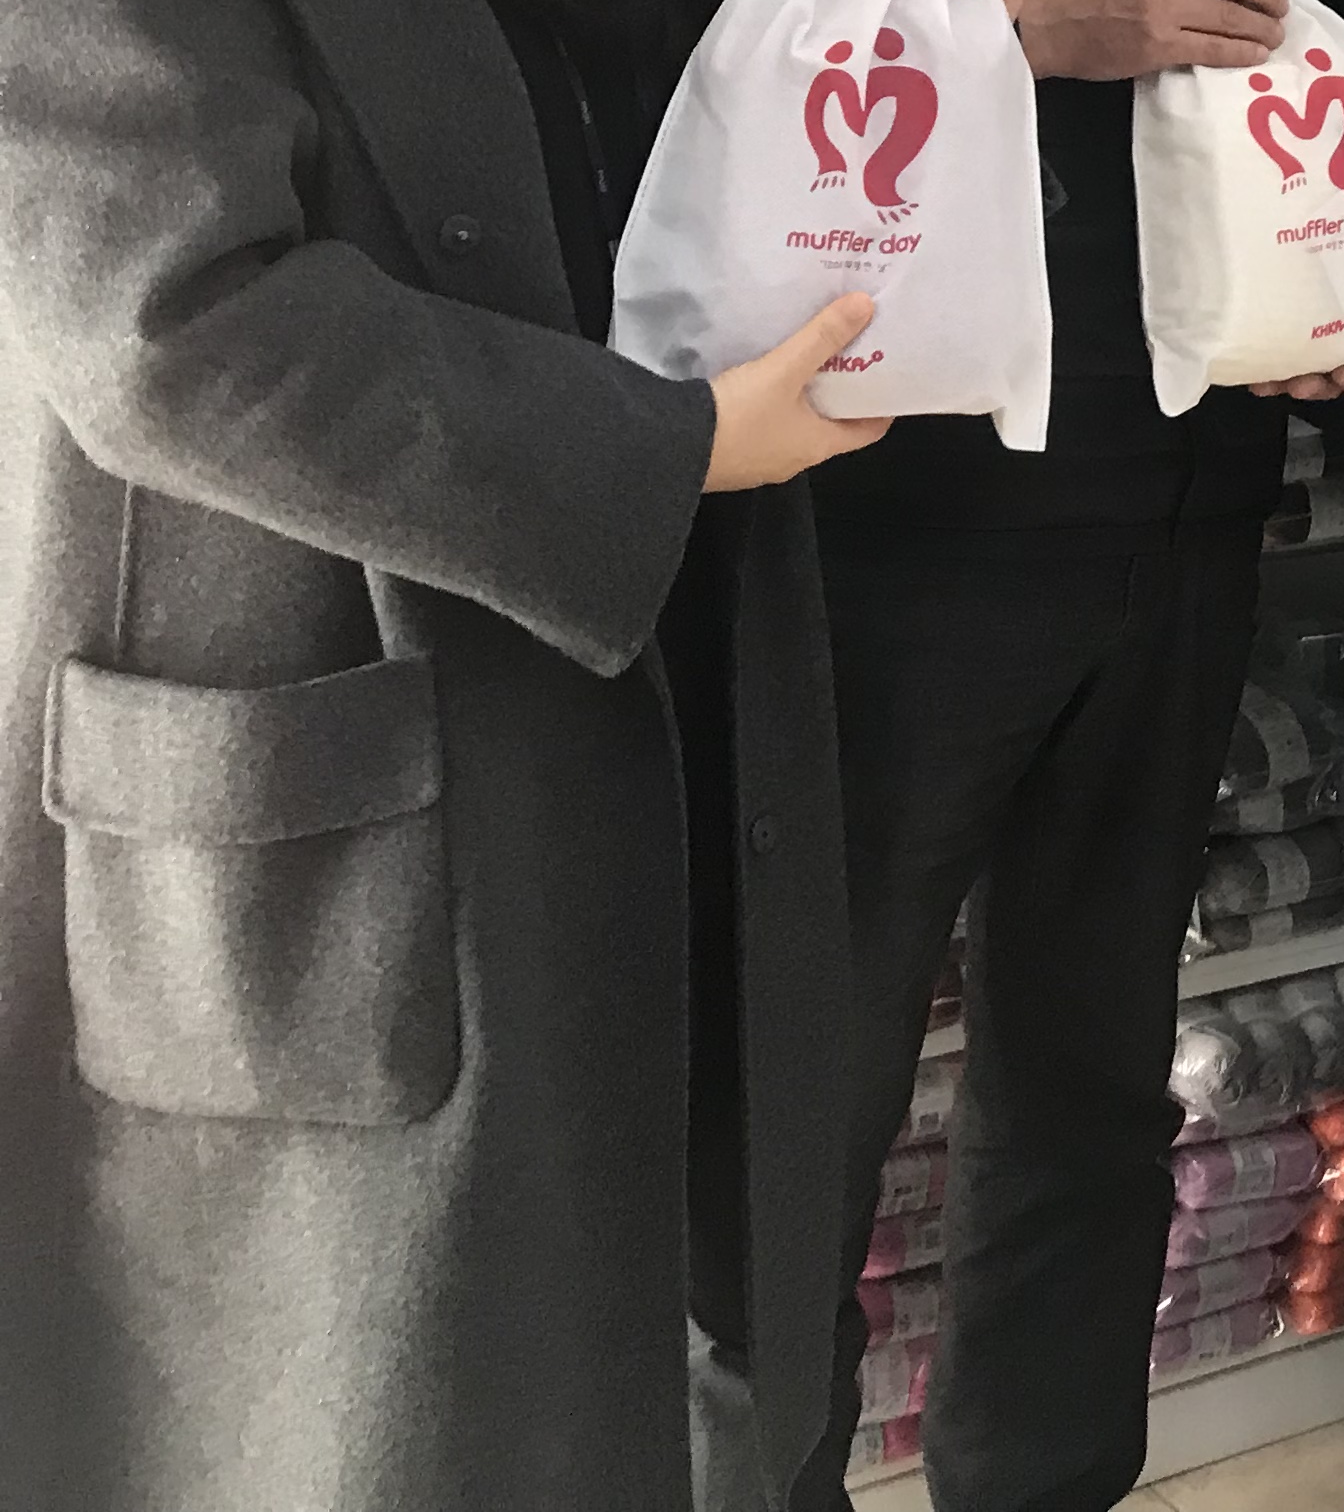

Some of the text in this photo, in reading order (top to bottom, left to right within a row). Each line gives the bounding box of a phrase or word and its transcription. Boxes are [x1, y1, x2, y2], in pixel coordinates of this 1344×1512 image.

[786, 229, 922, 255] muffler day
[1276, 217, 1344, 245] muffler
